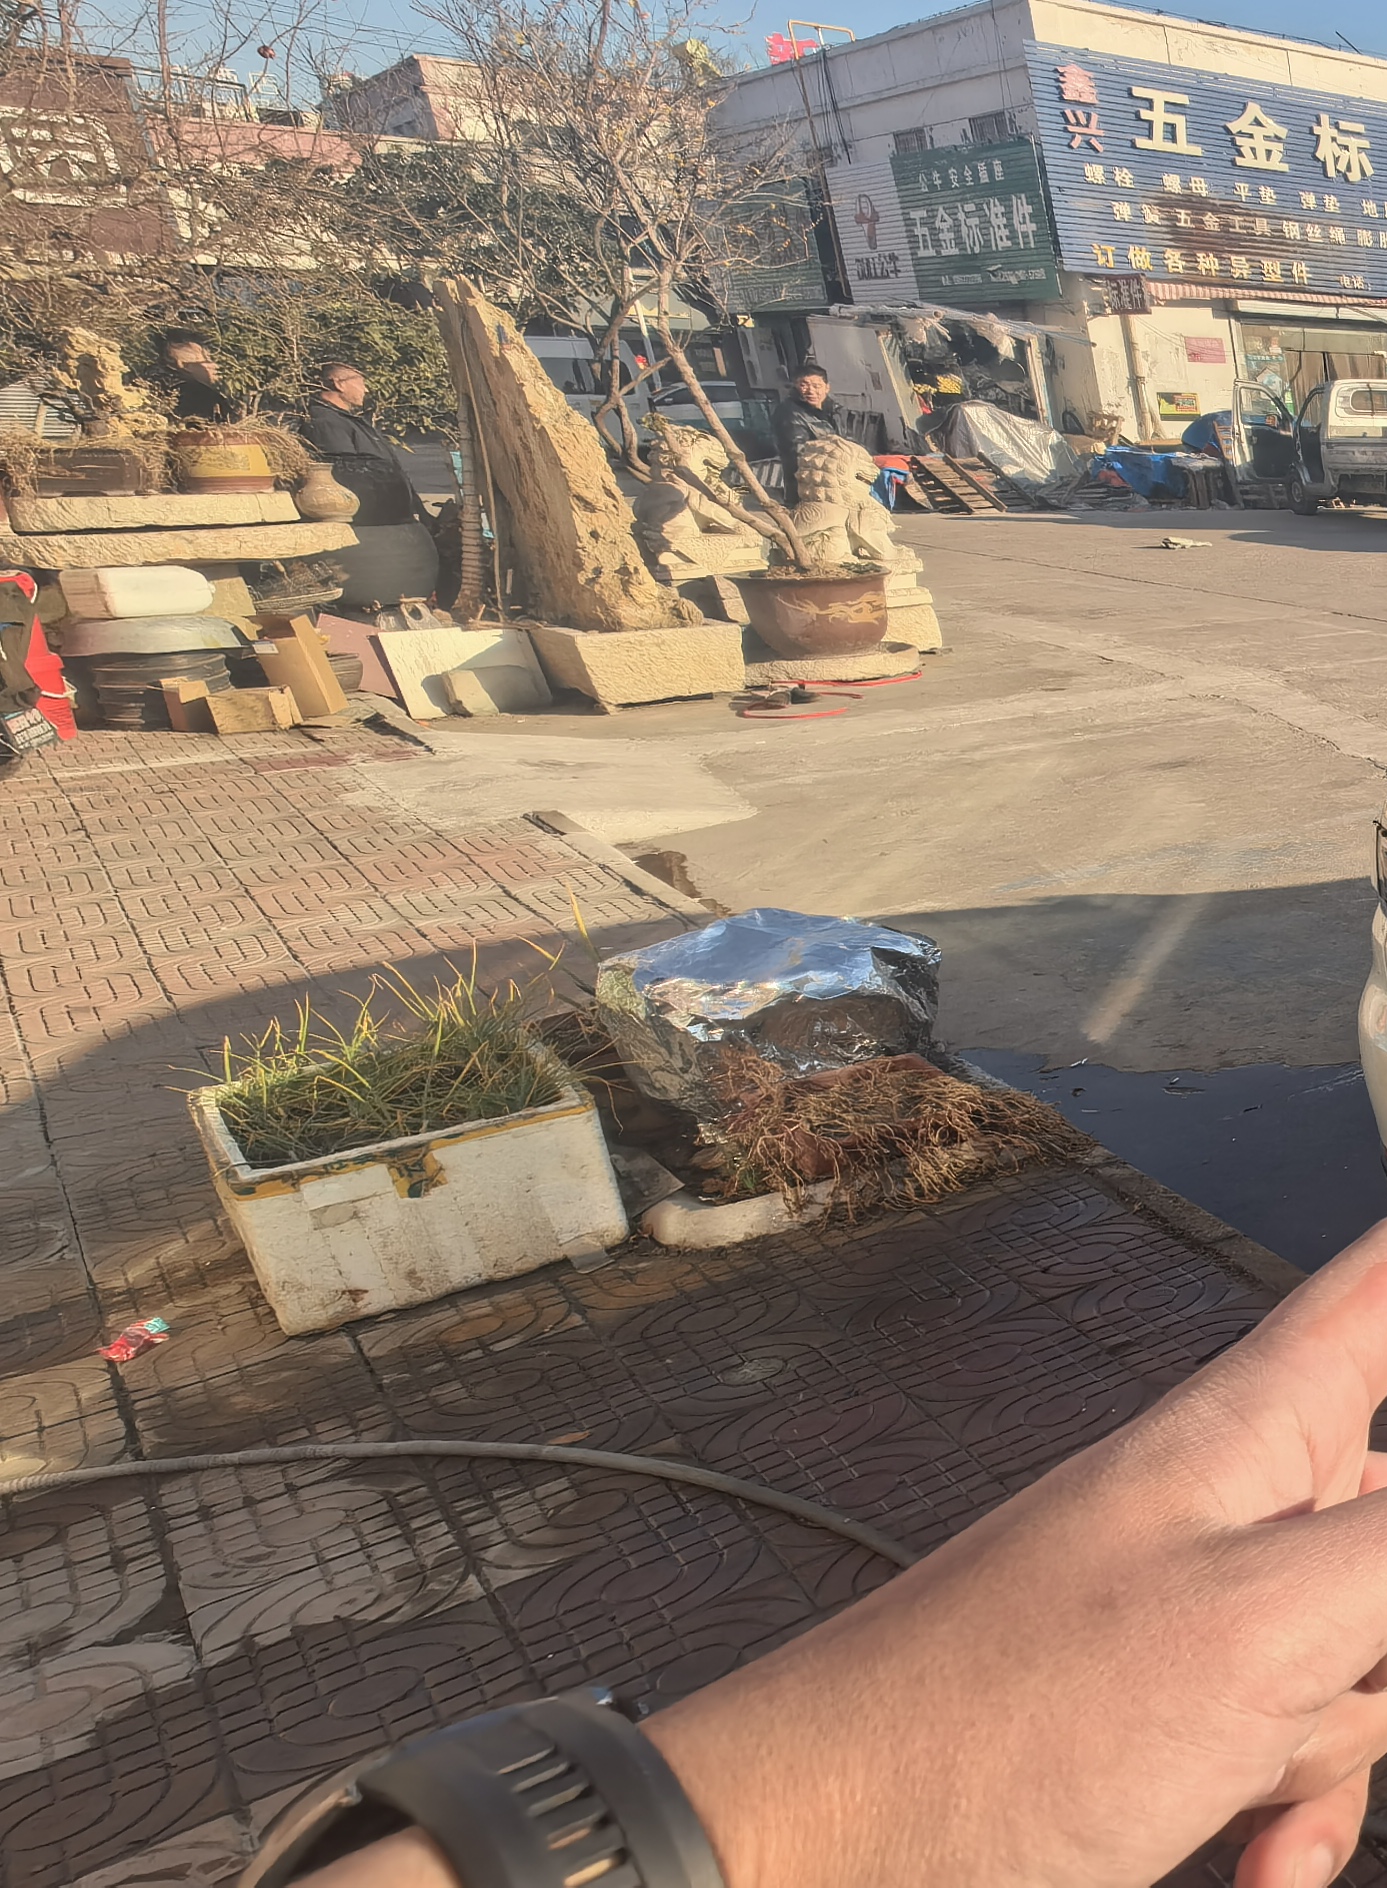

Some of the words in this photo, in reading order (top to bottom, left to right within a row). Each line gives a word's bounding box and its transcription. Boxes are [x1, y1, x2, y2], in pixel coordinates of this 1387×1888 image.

[1055, 63, 1104, 153] 鑫兴
[1084, 163, 1135, 189] 螺栓
[1162, 173, 1209, 197] 螺母
[1234, 182, 1277, 205] 平垫
[1299, 191, 1341, 214] 弹垫
[910, 192, 1037, 257] 五金标准件
[1092, 243, 1312, 285] 订做各种异型件
